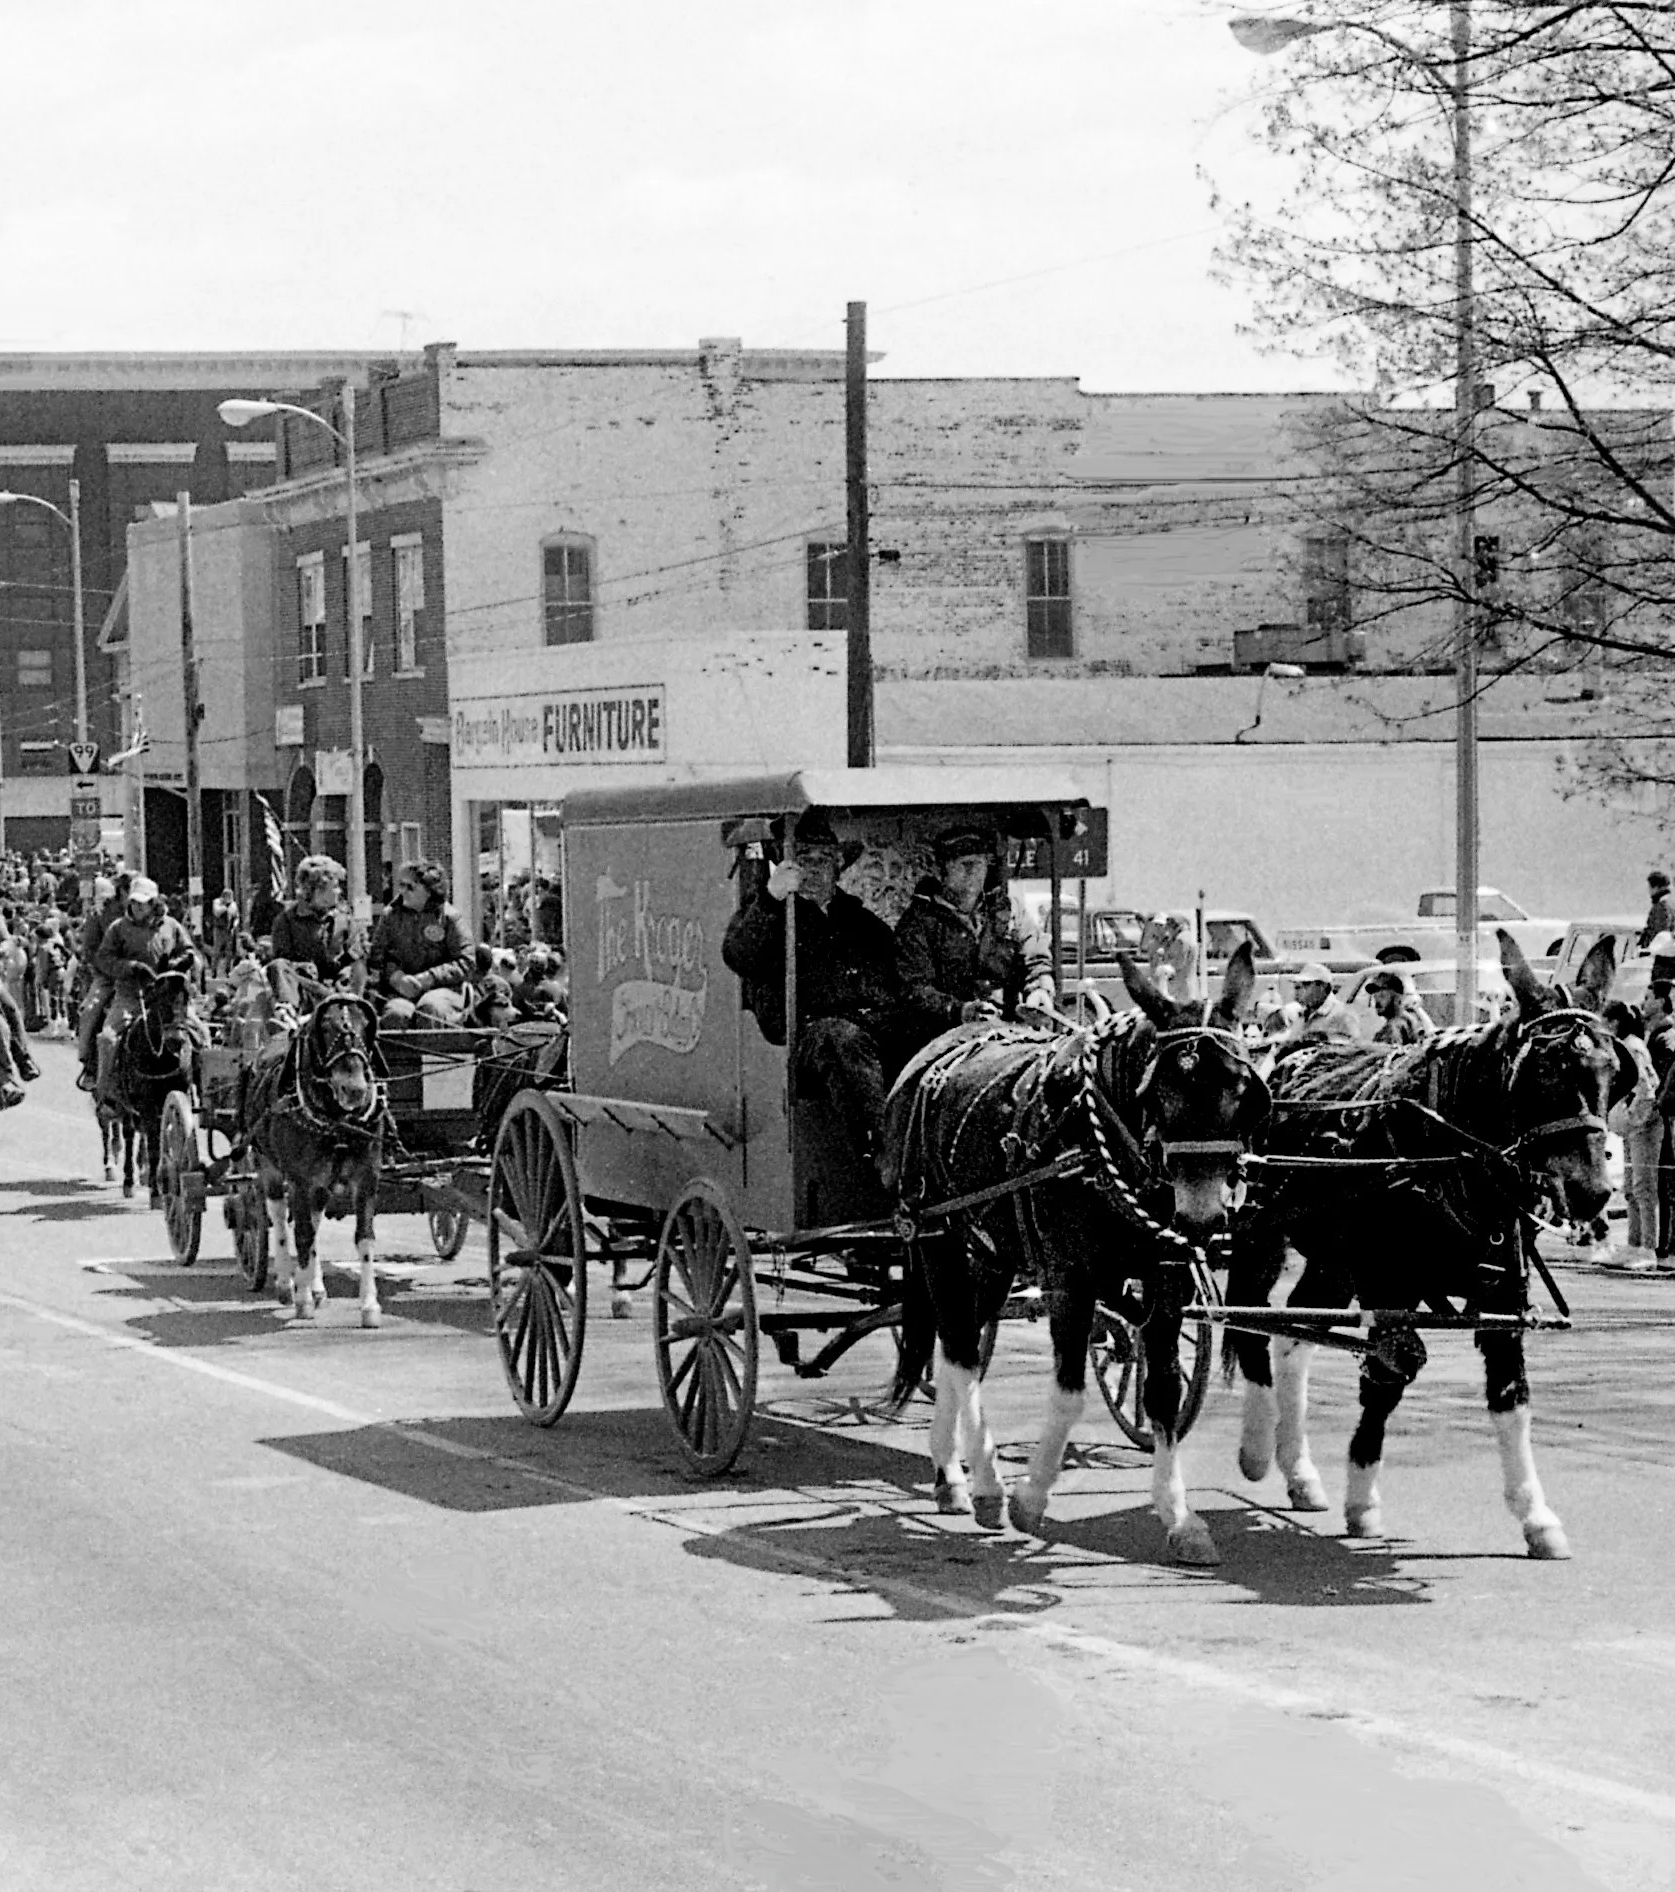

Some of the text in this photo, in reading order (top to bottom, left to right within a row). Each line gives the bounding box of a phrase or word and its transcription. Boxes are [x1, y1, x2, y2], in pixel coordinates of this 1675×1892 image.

[543, 698, 660, 754] FURNITURE
[75, 744, 94, 758] 99
[77, 801, 96, 815] TO
[1073, 849, 1090, 867] 41
